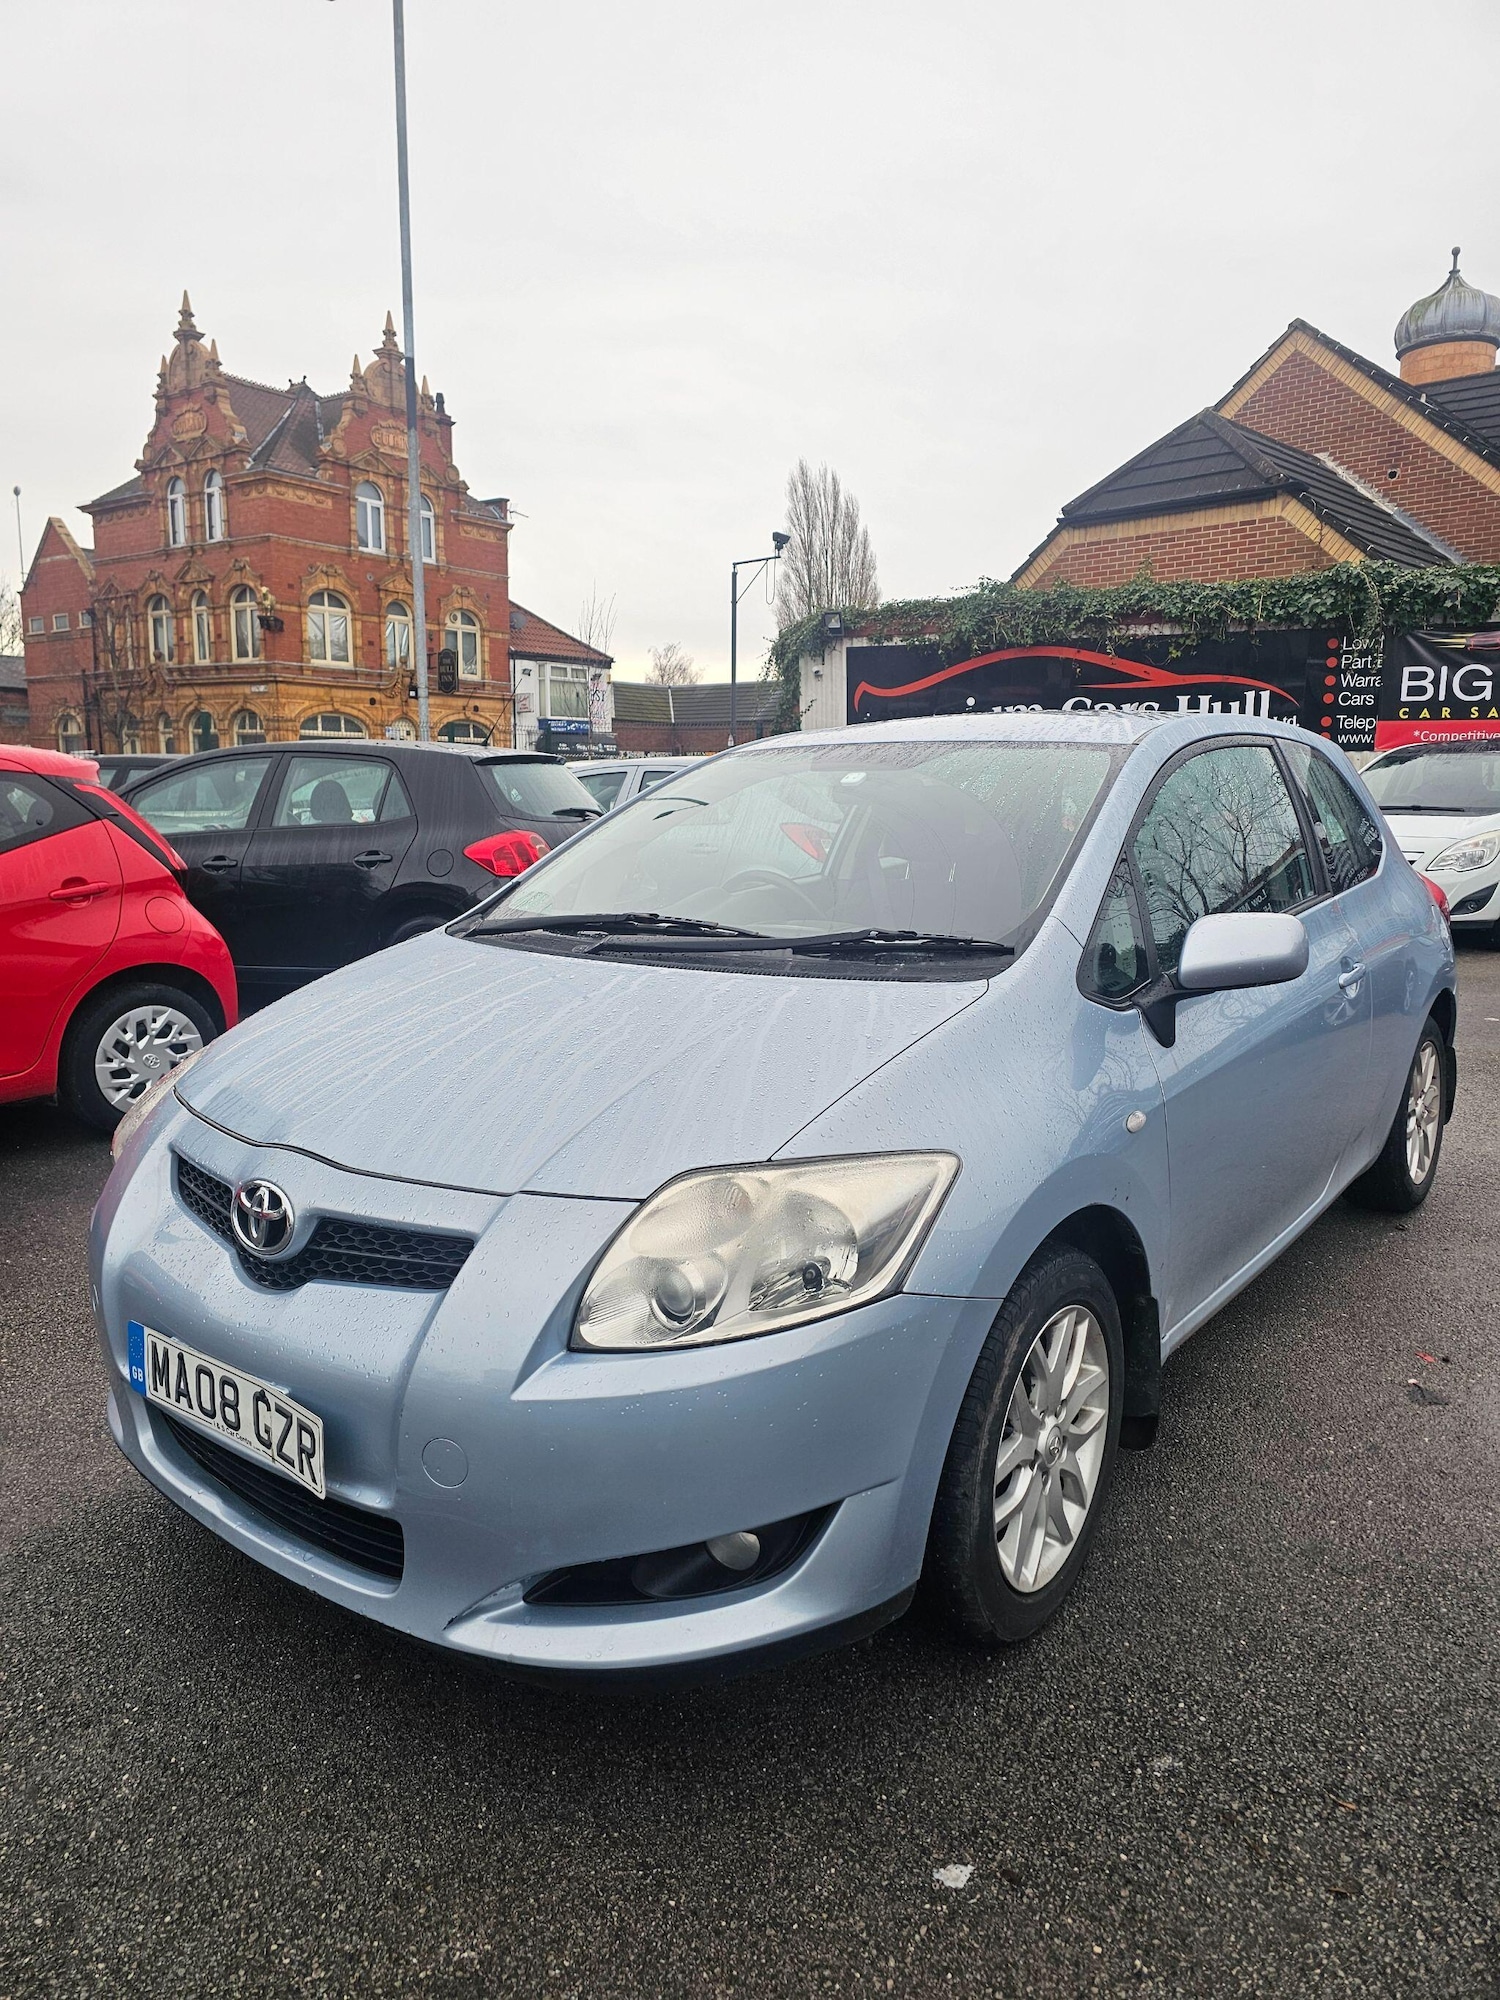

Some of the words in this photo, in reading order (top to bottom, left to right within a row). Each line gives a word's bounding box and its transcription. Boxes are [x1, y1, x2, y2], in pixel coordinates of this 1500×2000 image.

[1341, 654, 1372, 669] Part
[1400, 663, 1494, 702] BIG
[1338, 691, 1375, 706] Cars
[1398, 706, 1451, 719] CAR
[1470, 706, 1499, 719] SA
[1272, 714, 1300, 727] td.
[1335, 714, 1378, 732] Telep
[1337, 734, 1374, 744] www.
[131, 1365, 144, 1383] GB
[151, 1340, 241, 1432] MA08
[252, 1389, 318, 1486] GZR
